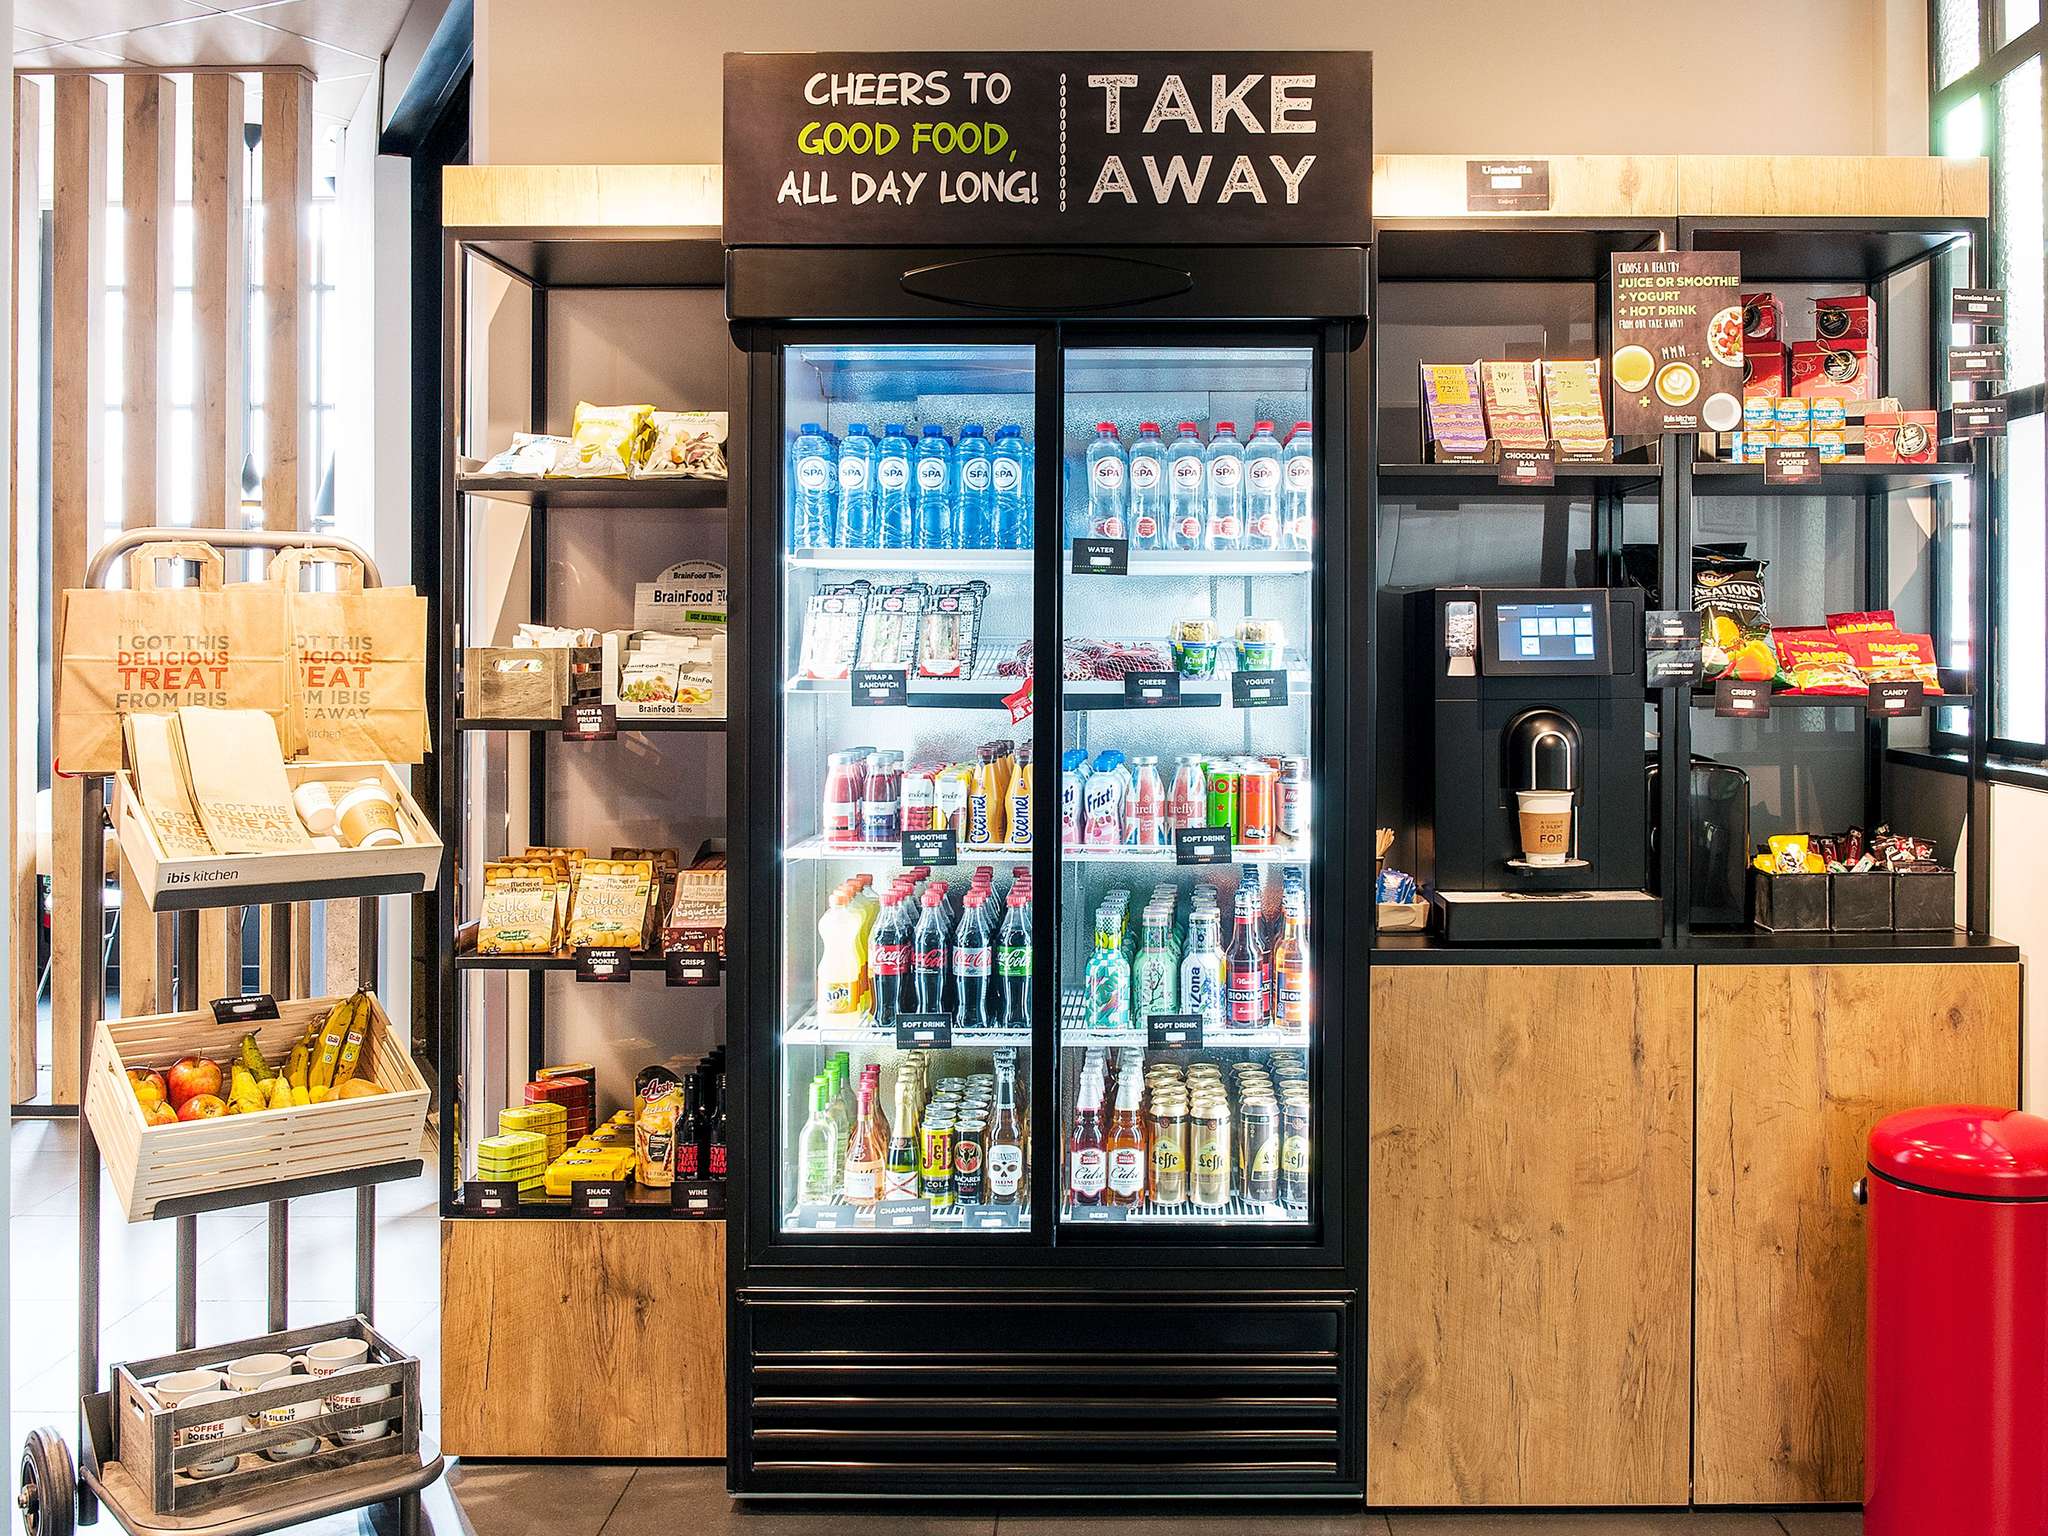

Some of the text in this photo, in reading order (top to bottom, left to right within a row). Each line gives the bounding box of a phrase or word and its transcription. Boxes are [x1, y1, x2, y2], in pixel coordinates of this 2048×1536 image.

[803, 70, 1012, 108] CHEERS TO
[1087, 73, 1318, 135] TAKE
[797, 121, 1017, 163] GOOD FOOD,
[1481, 165, 1533, 175] Umbrella
[1087, 154, 1318, 205] AWAY
[776, 169, 1041, 206] ALL DAY LONG!
[1618, 261, 1680, 274] CHOOSE A HEALTHY
[1618, 276, 1740, 289] JUICE OR SMOOTHIE
[1629, 291, 1681, 302] YOGURT
[1629, 306, 1656, 316] HOT
[1658, 305, 1697, 316] DRINK
[1618, 319, 1634, 329] FROM
[1648, 319, 1663, 329] TAKE
[1504, 452, 1550, 460] CHOCOLATE
[1776, 458, 1809, 466] COOKIES
[803, 469, 823, 477] SPA
[842, 469, 861, 477] SPA
[883, 469, 903, 477] SPA
[921, 470, 941, 478] SPA
[969, 470, 989, 478] SPA
[1099, 469, 1119, 477] SPA
[1134, 469, 1153, 477] SPA
[1177, 469, 1197, 477] SPA
[1216, 468, 1235, 476] SPA
[1253, 470, 1272, 478] SPA
[1088, 546, 1114, 554] WATER
[654, 589, 713, 603] BrainFood
[1835, 622, 1893, 634] HARIBO
[118, 635, 230, 650] I GOT THIS
[327, 636, 373, 650] THIS
[1867, 643, 1919, 652] HARIBO
[117, 651, 229, 666] DELICIOUS
[1871, 655, 1921, 666] Happy Cola
[117, 667, 229, 691] TREAT
[1244, 678, 1276, 686] YOGURT
[1730, 688, 1757, 696] CRISPS
[1882, 689, 1909, 697] CANDY
[116, 692, 228, 708] FROM IBIS
[331, 690, 371, 705] IBIS
[314, 707, 371, 720] AWAY
[639, 704, 675, 713] BrainFood
[1087, 784, 1113, 813] Fristi
[213, 803, 247, 812] GOT
[249, 804, 288, 814] THIS
[207, 809, 292, 823] DELICIOUS
[211, 814, 294, 832] TREAT
[216, 824, 266, 837] FROM
[261, 835, 303, 845] AWAY
[910, 833, 948, 841] SMOOTHIE
[1182, 835, 1201, 843] SOFT
[1540, 834, 1563, 843] FOR
[922, 841, 943, 849] JUICE
[166, 870, 240, 885] ibis kitchen
[587, 957, 620, 965] COOKIES
[680, 958, 706, 966] CRISPS
[903, 1021, 922, 1029] SOFT
[1153, 1151, 1178, 1169] Leffe
[586, 1188, 612, 1196] SNACK
[880, 1205, 927, 1214] CHAMPAGNE
[332, 1395, 361, 1404] COFFEE
[268, 1413, 296, 1422] SILENT
[188, 1431, 225, 1441] DOESN'T
